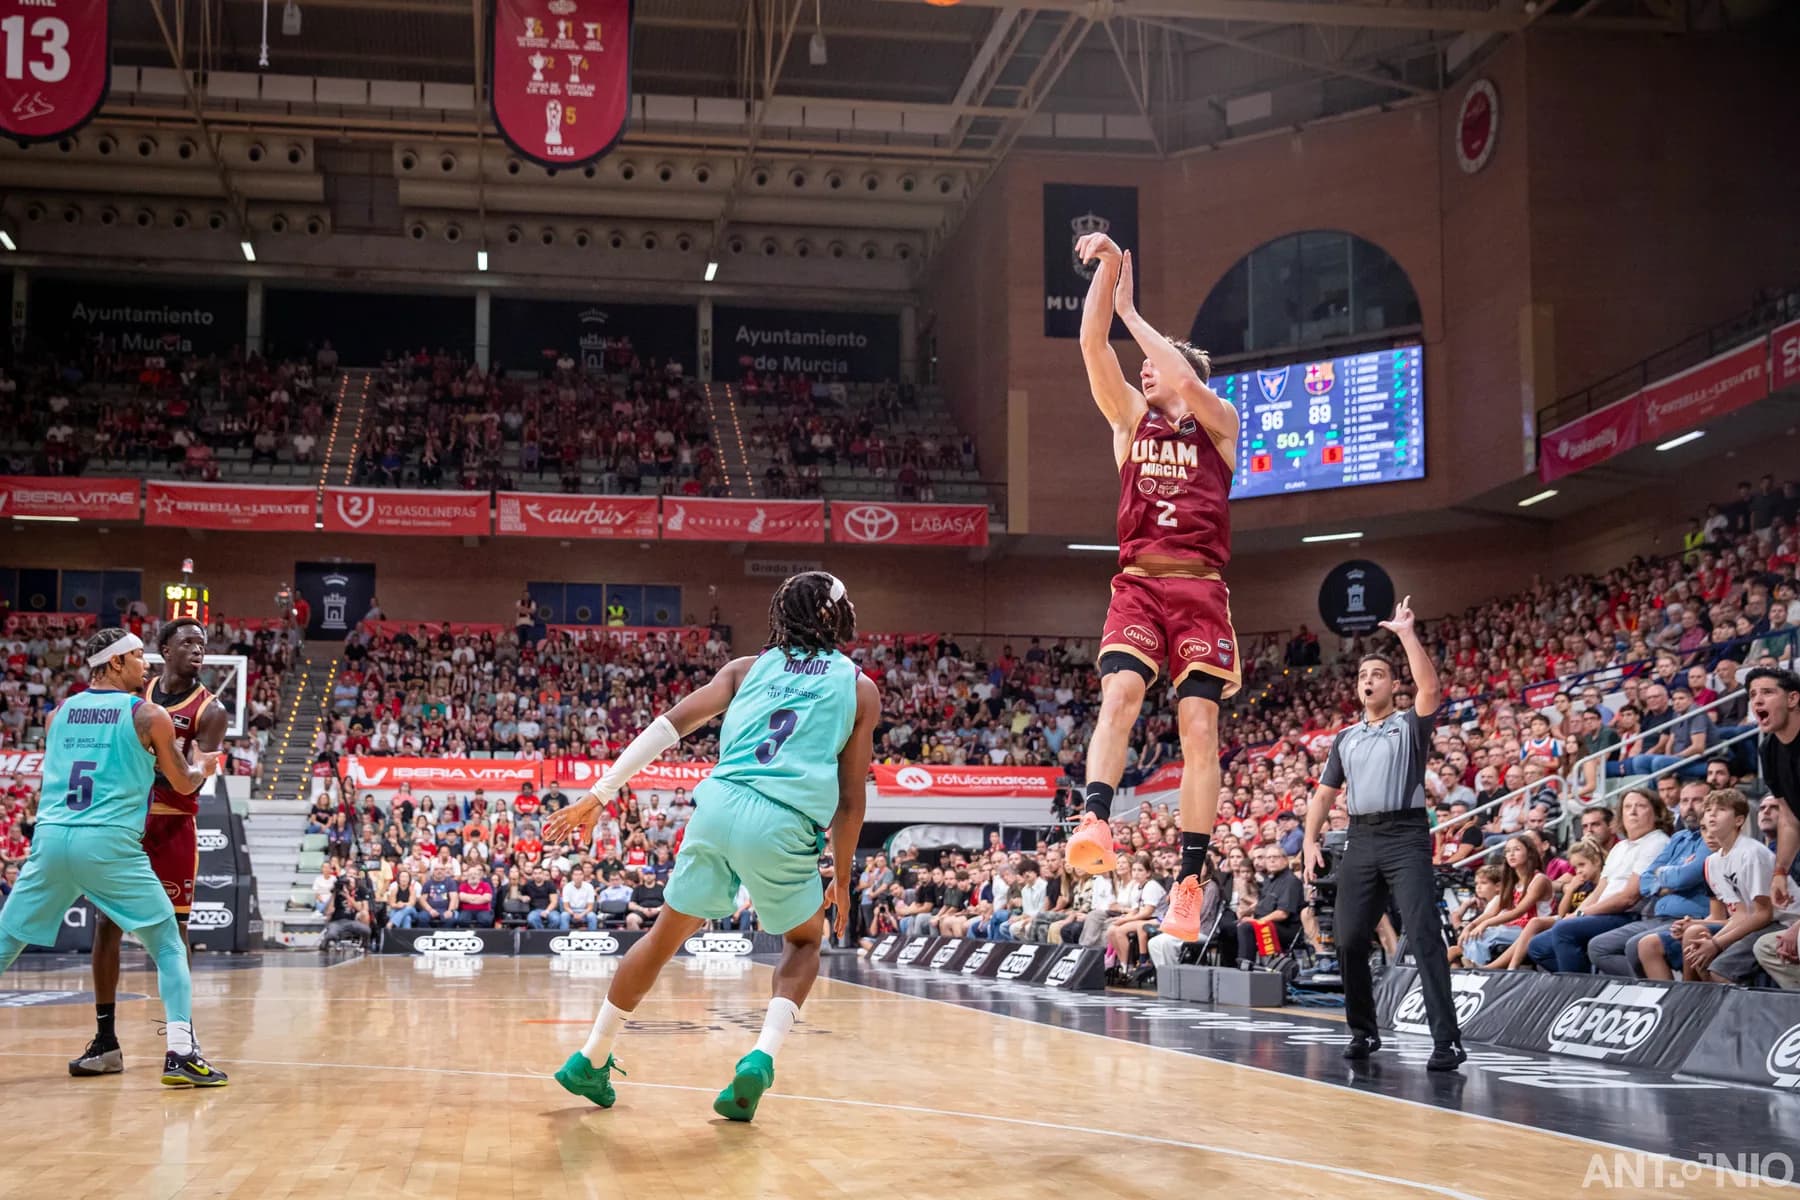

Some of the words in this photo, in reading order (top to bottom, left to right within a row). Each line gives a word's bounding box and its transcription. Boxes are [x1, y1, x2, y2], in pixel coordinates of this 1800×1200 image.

[1, 15, 71, 83] 13
[565, 106, 577, 125] 5
[546, 146, 575, 156] LIGAS
[72, 301, 214, 325] Ayuntamiento
[735, 325, 867, 347] Ayuntamiento
[754, 356, 778, 370] de
[783, 355, 848, 373] Murcia
[1261, 411, 1284, 431] 96
[1308, 404, 1332, 424] 89
[1276, 430, 1315, 449] 50.1
[1131, 439, 1198, 467] UCAM
[12, 490, 76, 504] IBERIA
[78, 492, 134, 504] VITAE
[176, 501, 241, 513] ESTRELLA
[252, 503, 310, 515] LEVANTE
[377, 505, 392, 516] V2
[394, 506, 477, 518] GASOLINERAS
[1156, 500, 1178, 527] 2
[911, 517, 976, 534] LABASA
[1126, 630, 1156, 647] Juver
[67, 708, 121, 724] ROBINSON
[755, 709, 798, 764] 3
[393, 767, 467, 778] IBERIA
[469, 769, 535, 778] VITAE
[936, 774, 1047, 786] rótulosmarcos
[66, 761, 97, 812] 5
